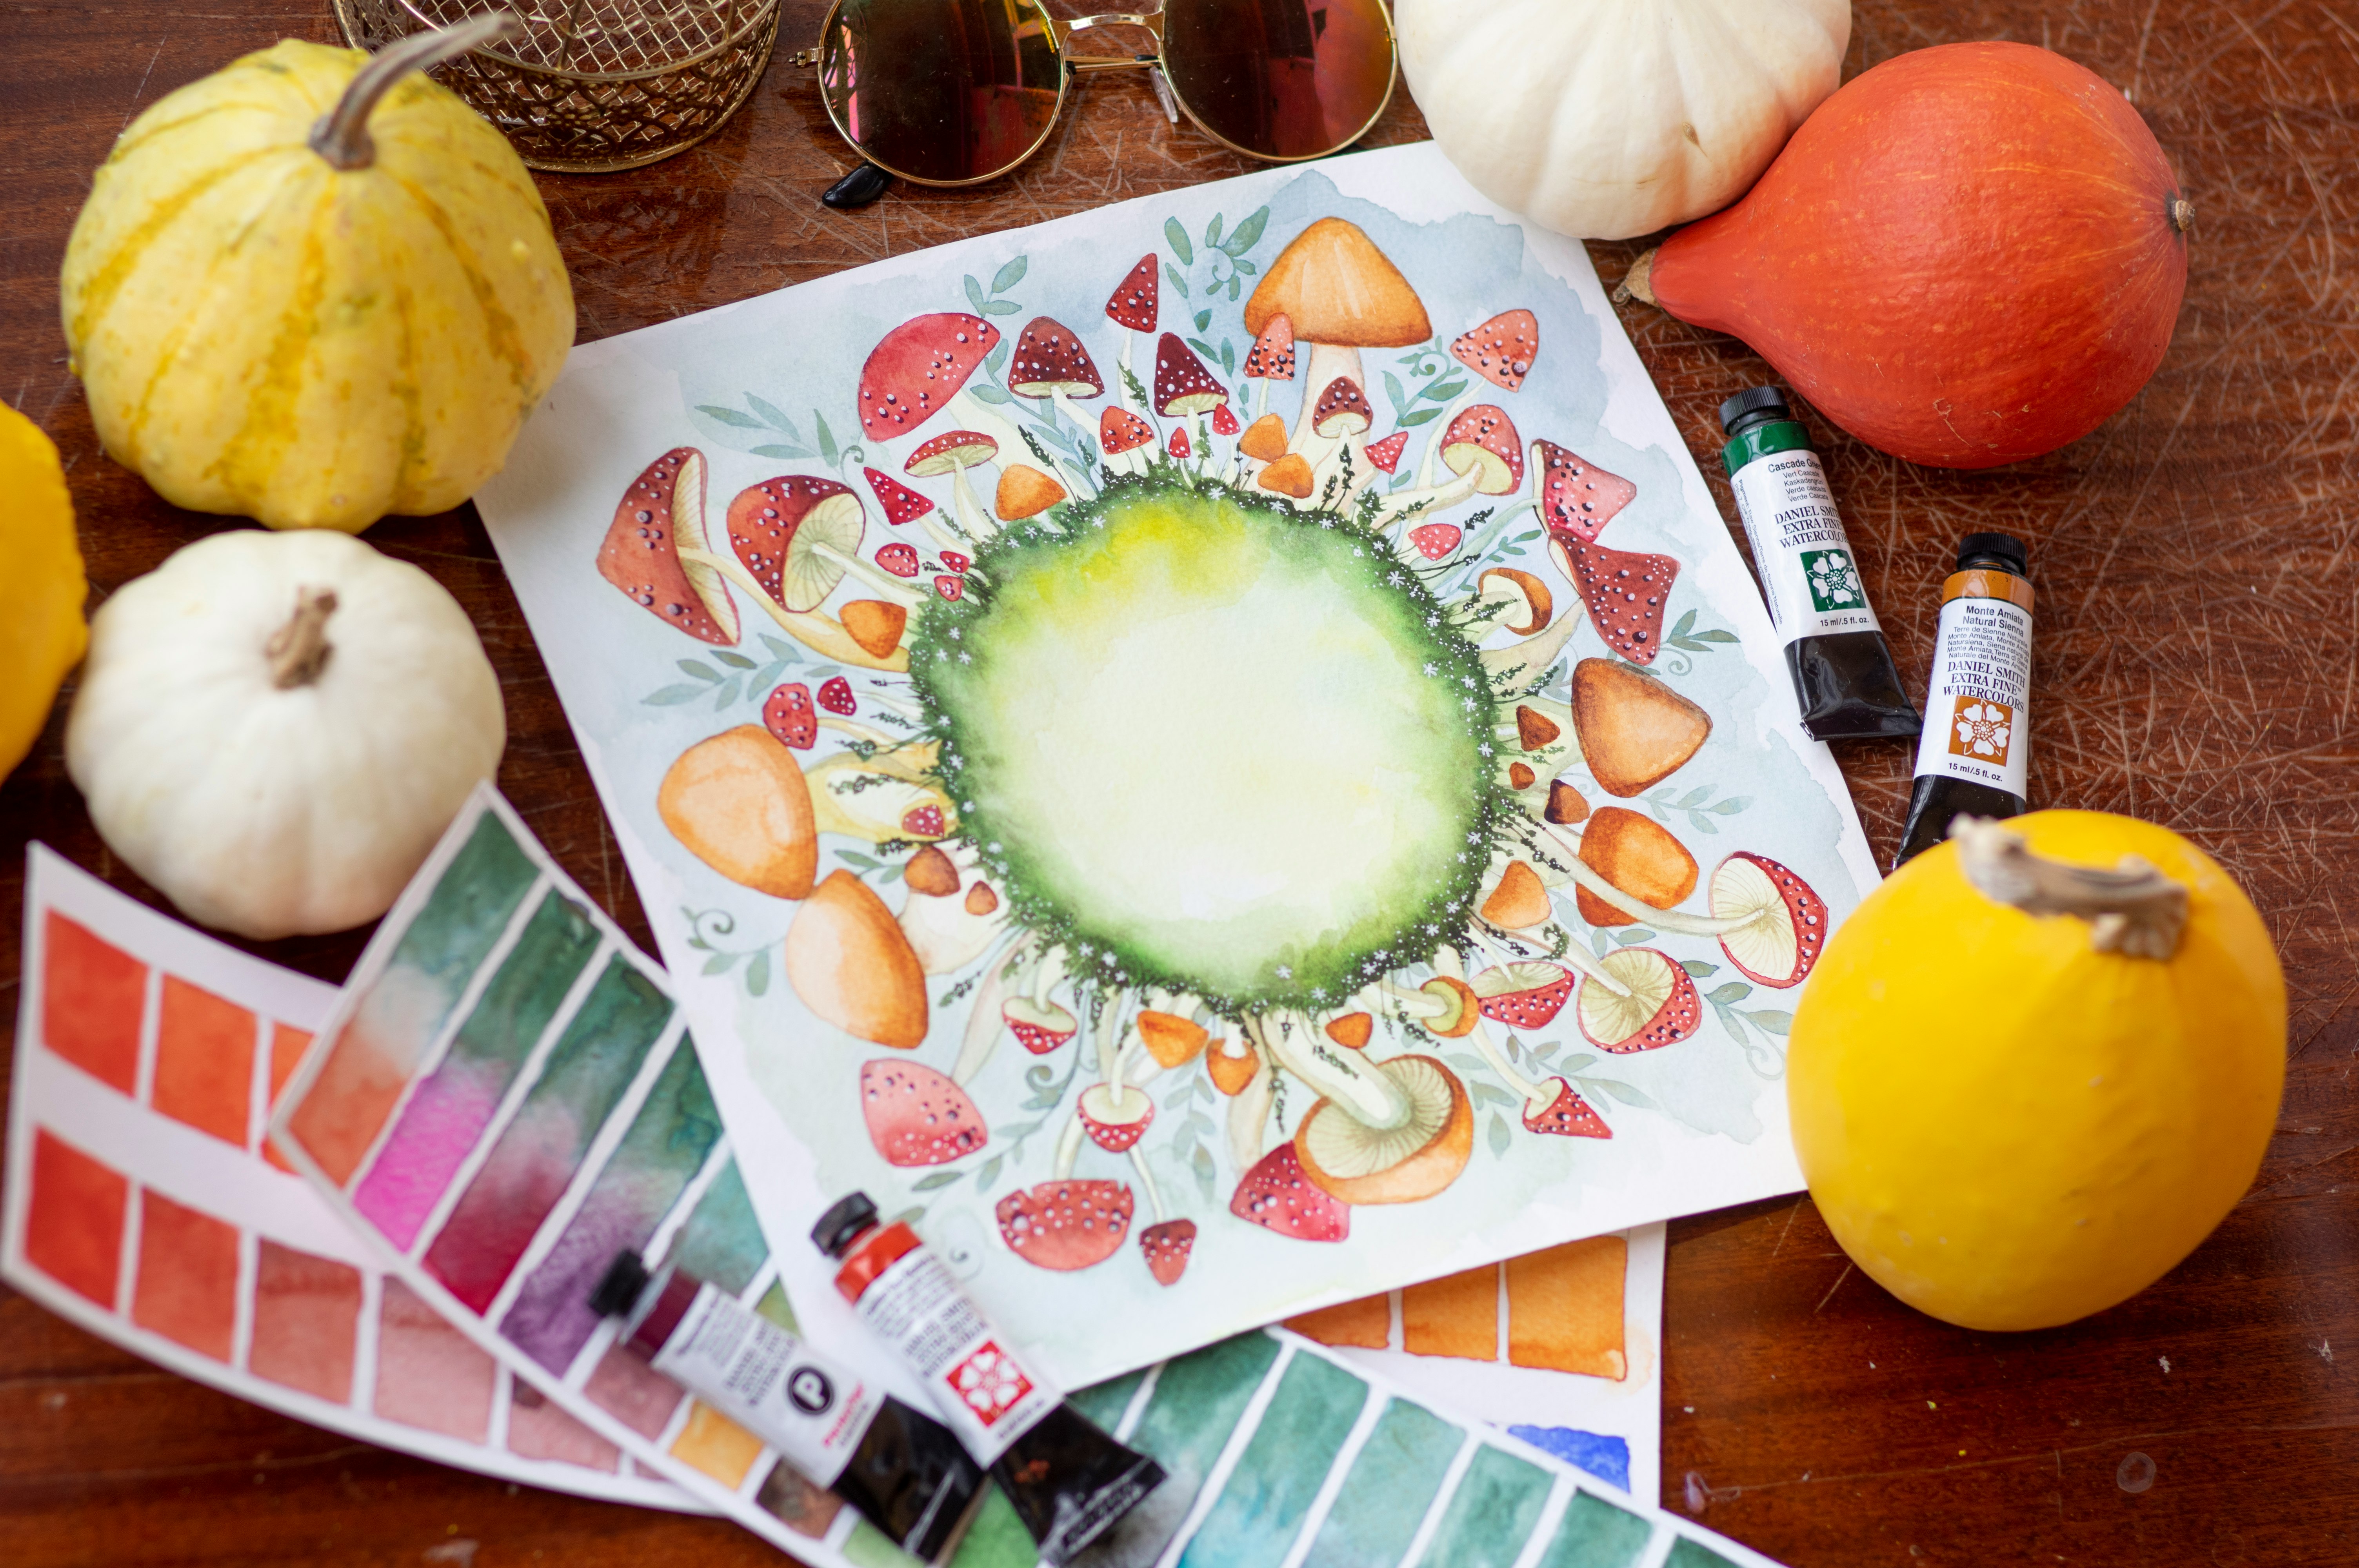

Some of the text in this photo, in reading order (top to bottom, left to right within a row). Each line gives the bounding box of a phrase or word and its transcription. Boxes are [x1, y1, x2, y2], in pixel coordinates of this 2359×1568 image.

[1768, 458, 1822, 473] Cascade Green
[1784, 477, 1823, 486] Kaskadengrün
[1786, 486, 1805, 494] Verde
[1788, 494, 1808, 502] Verde
[1774, 506, 1819, 524] DANIEL
[1782, 518, 1822, 535] EXTRA
[1738, 479, 1749, 509] Pigment:
[1752, 524, 1765, 564] Sienna/Terre
[1764, 564, 1768, 573] de
[1766, 573, 1775, 596] Sienne
[1773, 596, 1783, 624] Naturelle
[1830, 617, 1848, 626] ml/.5
[1966, 606, 2023, 626] Monte Amiata
[1963, 616, 2023, 637] Natural Sienna
[1969, 632, 1994, 642] Amiata,
[1997, 636, 2015, 647] Monte
[2017, 644, 2029, 658] Amiata
[1983, 628, 2005, 637] Sienne
[2007, 632, 2028, 649] Naturelle
[1987, 641, 2005, 651] Siena
[2007, 647, 2024, 659] natural
[1990, 655, 2010, 666] Monte
[2011, 663, 2026, 675] Amiata
[2017, 657, 2028, 670] Siena
[1947, 661, 2025, 688] DANIEL SMITH
[1951, 673, 1989, 686] EXTRA
[1943, 685, 2024, 713] WATERCOLORS
[1960, 766, 1980, 775] ml/.5
